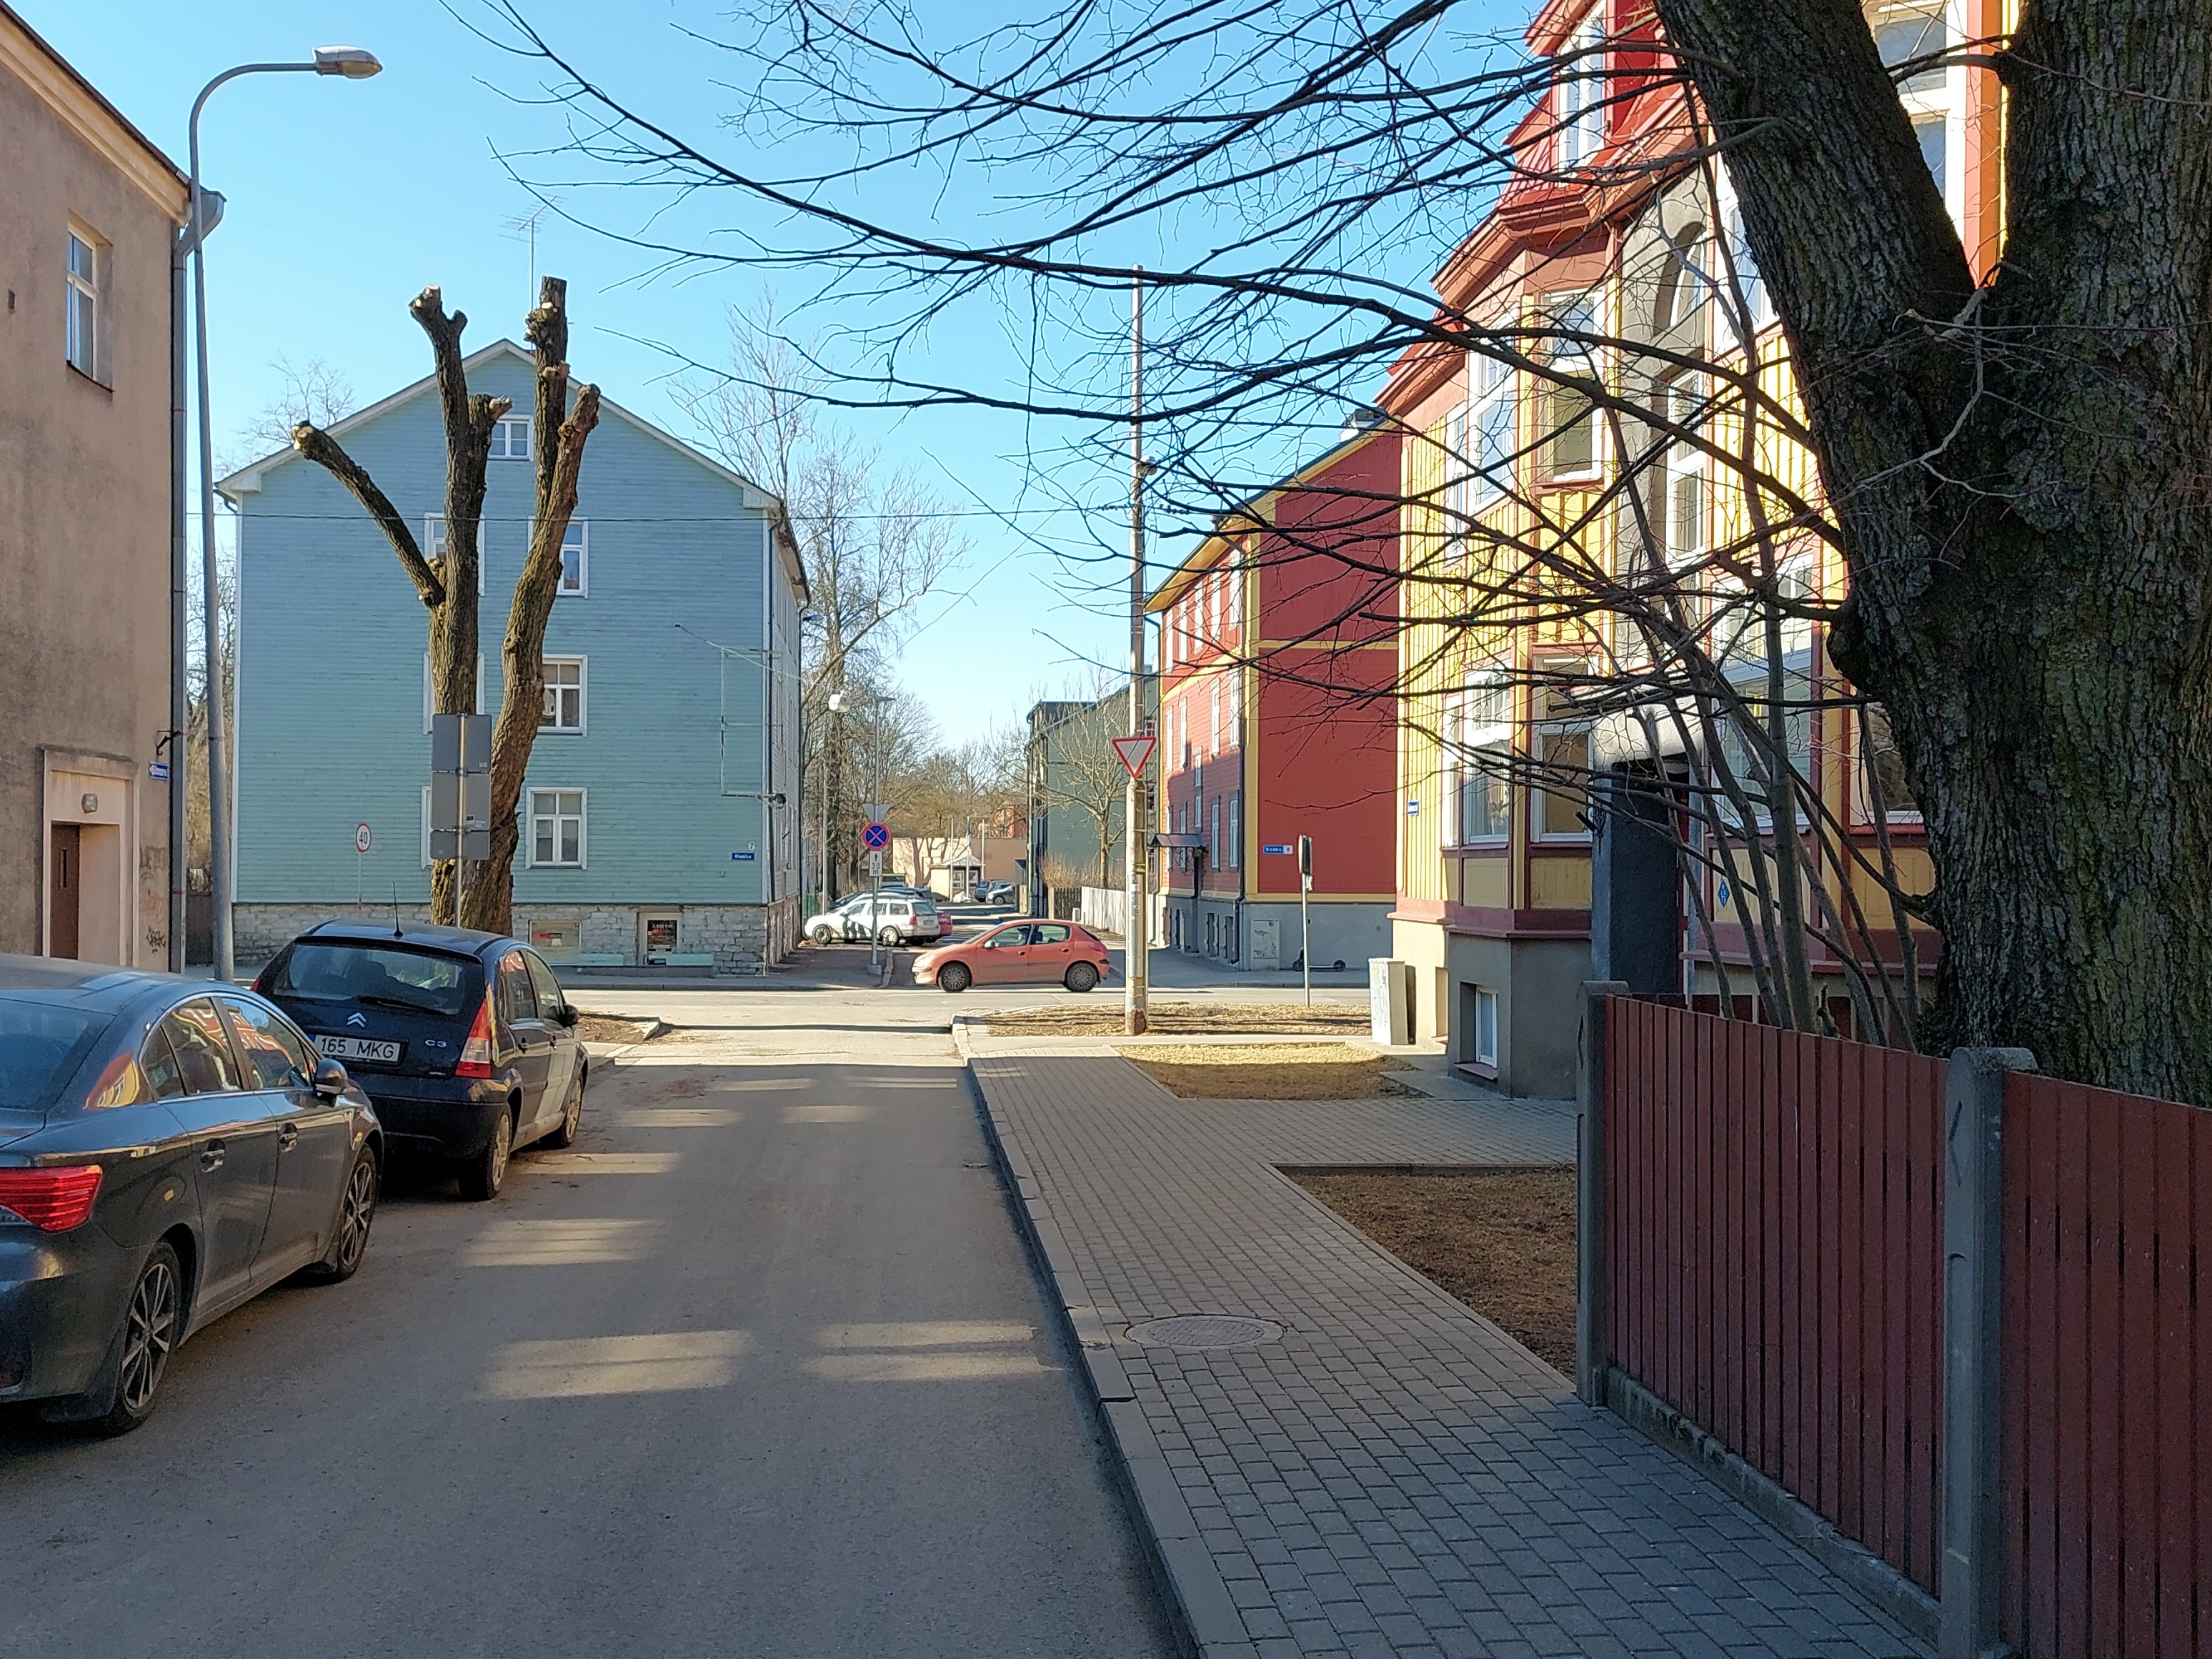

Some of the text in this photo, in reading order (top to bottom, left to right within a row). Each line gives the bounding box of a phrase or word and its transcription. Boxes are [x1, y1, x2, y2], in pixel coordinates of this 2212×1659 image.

[359, 831, 368, 845] 40
[320, 1037, 395, 1059] 165 MKG
[424, 1039, 447, 1048] C3
